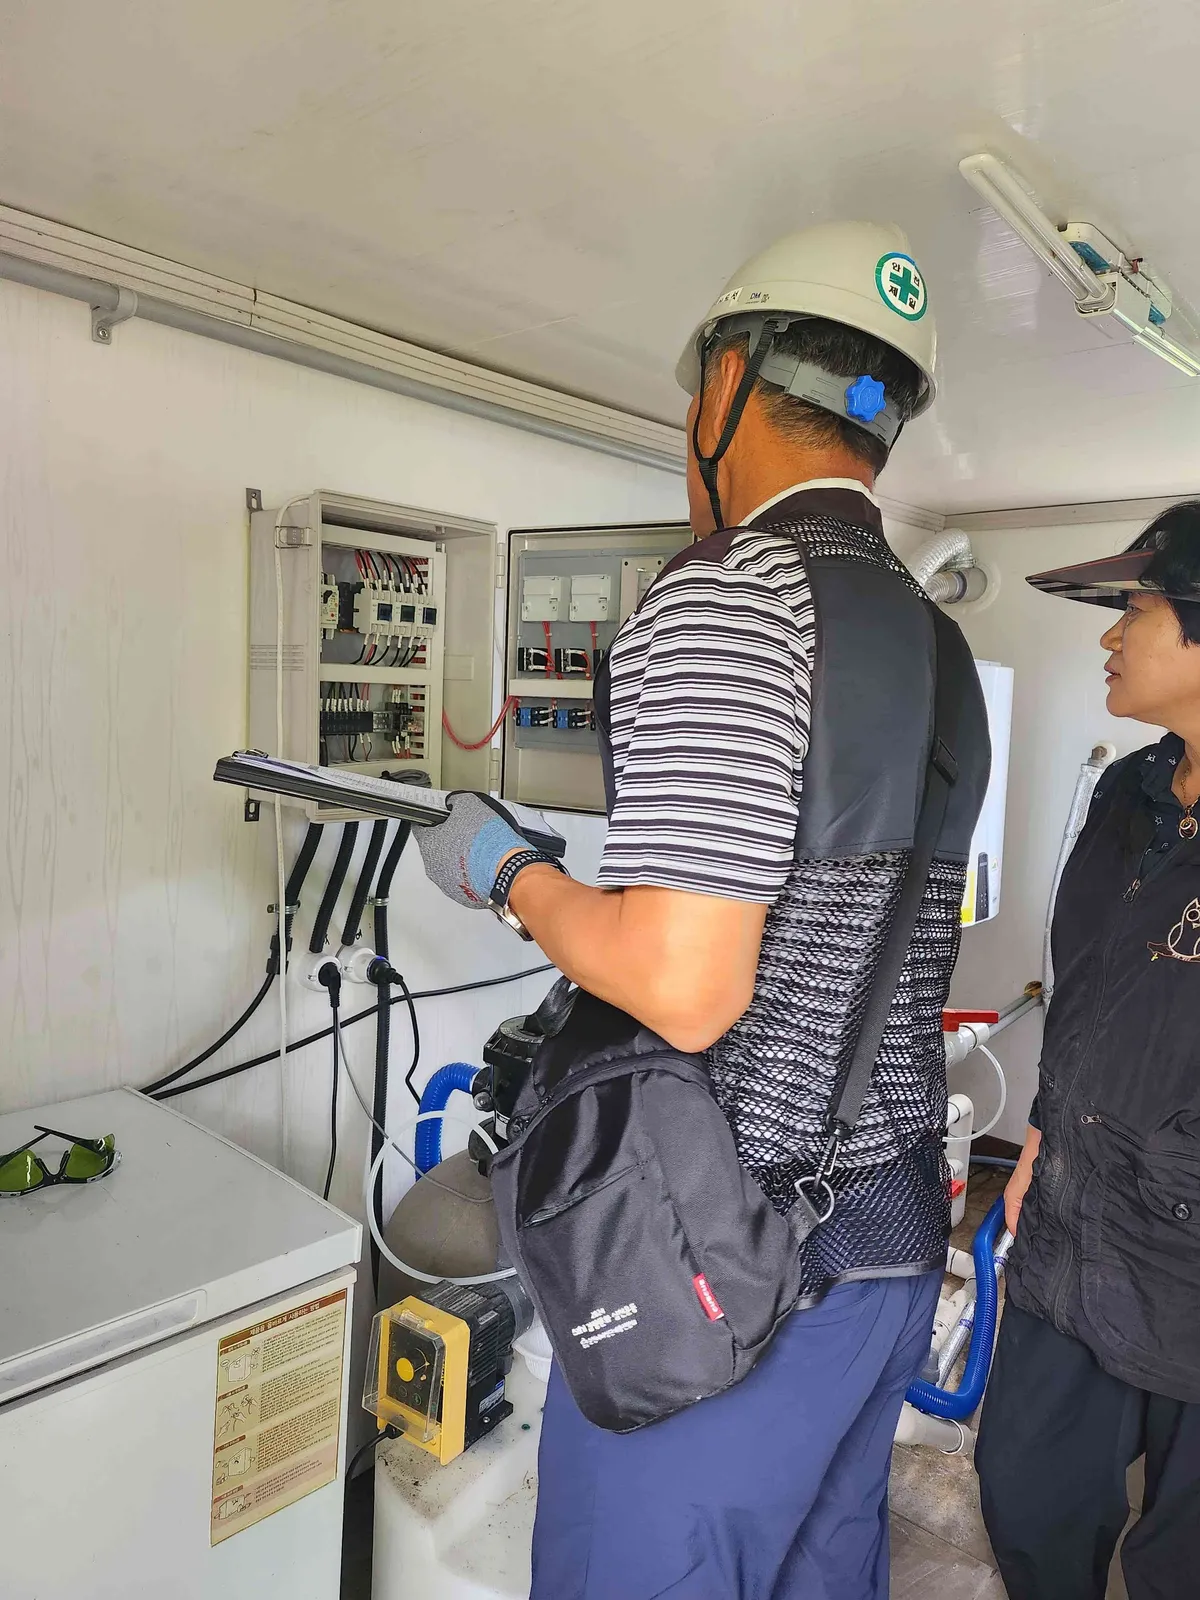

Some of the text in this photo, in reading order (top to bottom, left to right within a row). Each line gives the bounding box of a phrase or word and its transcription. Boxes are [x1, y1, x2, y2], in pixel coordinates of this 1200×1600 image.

[892, 262, 901, 273] 안
[889, 285, 917, 310] 제 일
